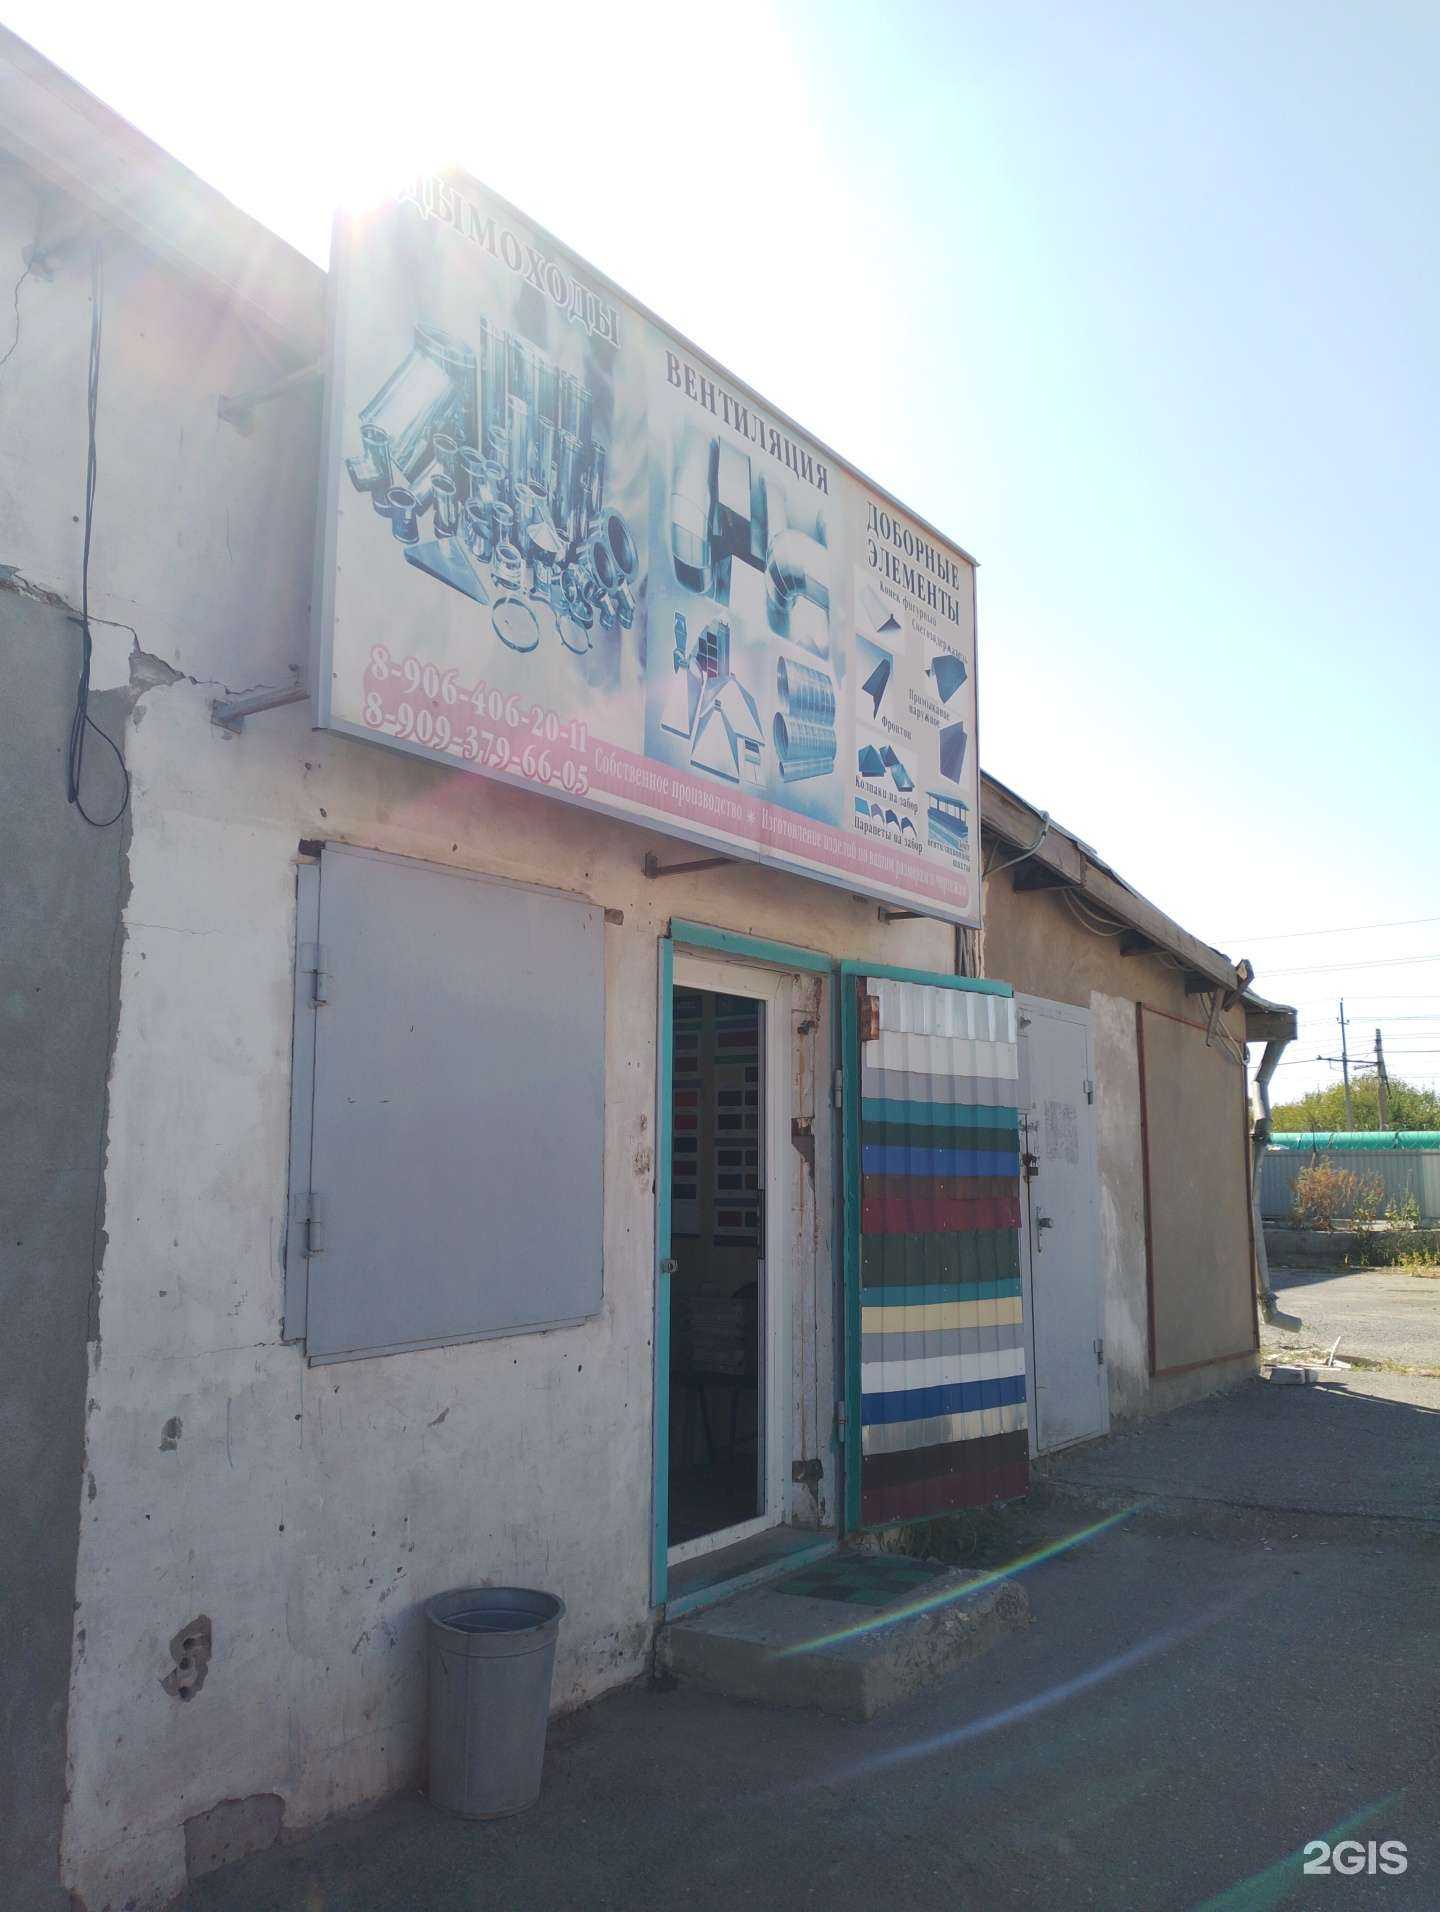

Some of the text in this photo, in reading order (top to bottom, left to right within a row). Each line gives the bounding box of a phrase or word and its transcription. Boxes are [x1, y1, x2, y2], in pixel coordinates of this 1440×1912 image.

[665, 350, 829, 496] ВЕНТИЛЯЦИЯ
[866, 501, 960, 591] ДОБОРНЫЕ
[867, 538, 960, 626] ЭЛЕМЕНТЫ
[364, 690, 590, 795] 8-909-379-66-05
[370, 646, 590, 753] 8-906-406-20-11
[594, 747, 670, 795] Собственное
[671, 779, 744, 819] производство
[761, 807, 823, 847] Изготовление
[854, 815, 892, 840] Парапеты
